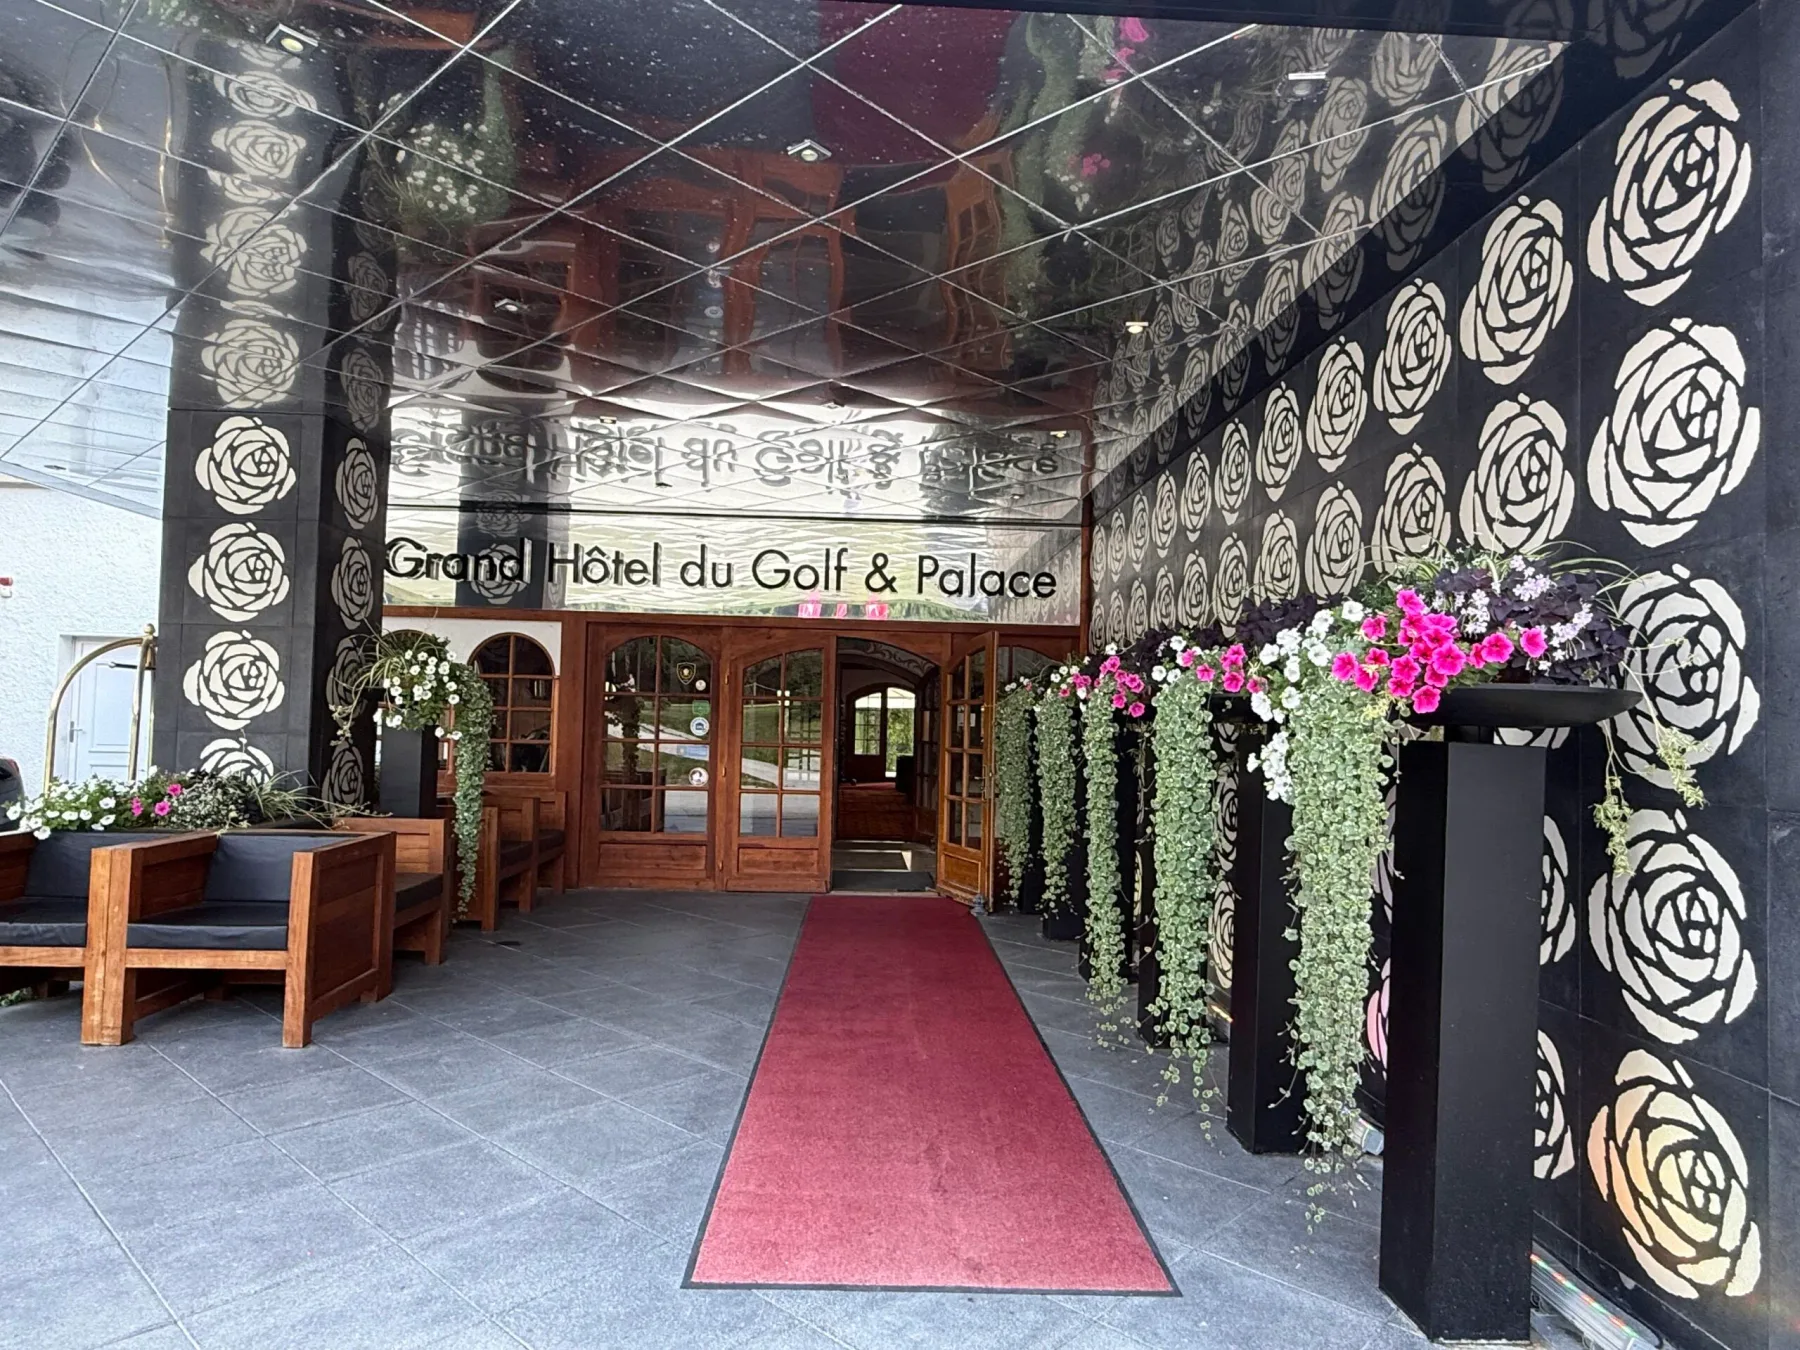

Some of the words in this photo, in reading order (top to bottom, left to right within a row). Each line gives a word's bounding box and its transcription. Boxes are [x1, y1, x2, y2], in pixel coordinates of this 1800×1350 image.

[383, 537, 529, 582] Grand
[548, 541, 660, 586] Hôtel
[680, 543, 732, 588] du
[752, 547, 848, 592] Golf
[865, 552, 898, 593] &
[917, 552, 1057, 598] Palace
